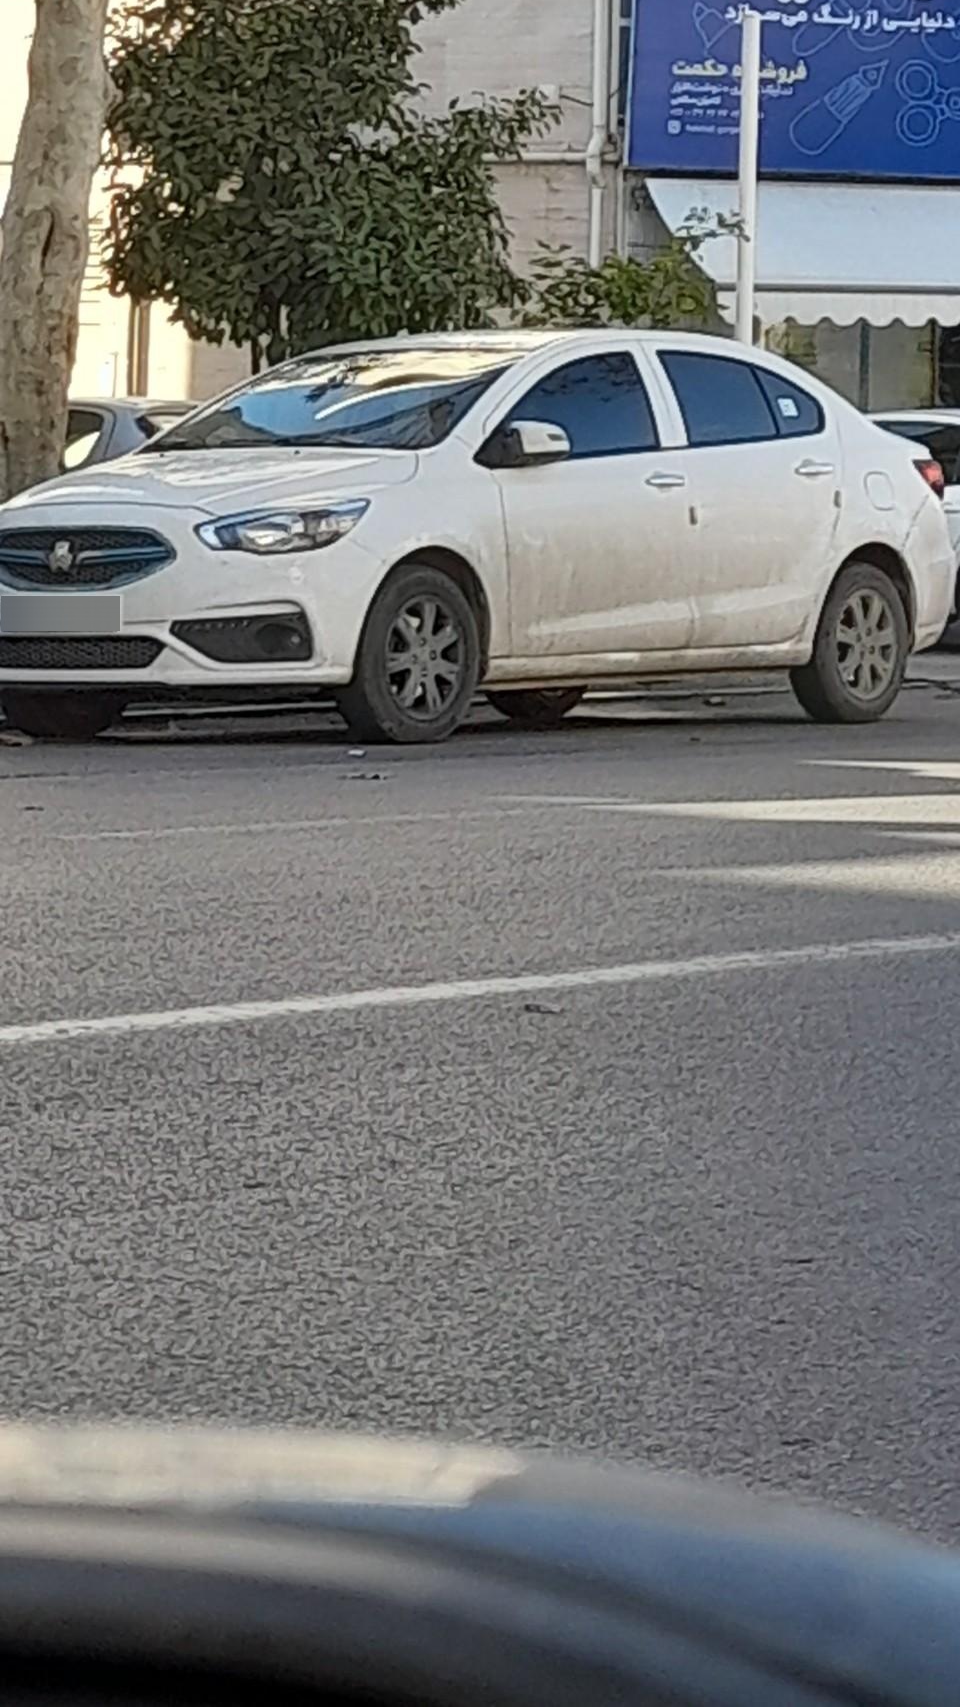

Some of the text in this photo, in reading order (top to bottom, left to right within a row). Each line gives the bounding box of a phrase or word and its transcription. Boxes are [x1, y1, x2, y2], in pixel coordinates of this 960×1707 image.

[812, 2, 861, 30] رنگ
[862, 9, 880, 31] از
[882, 10, 956, 33] دنیایی
[671, 58, 808, 84] فروشه حکمت
